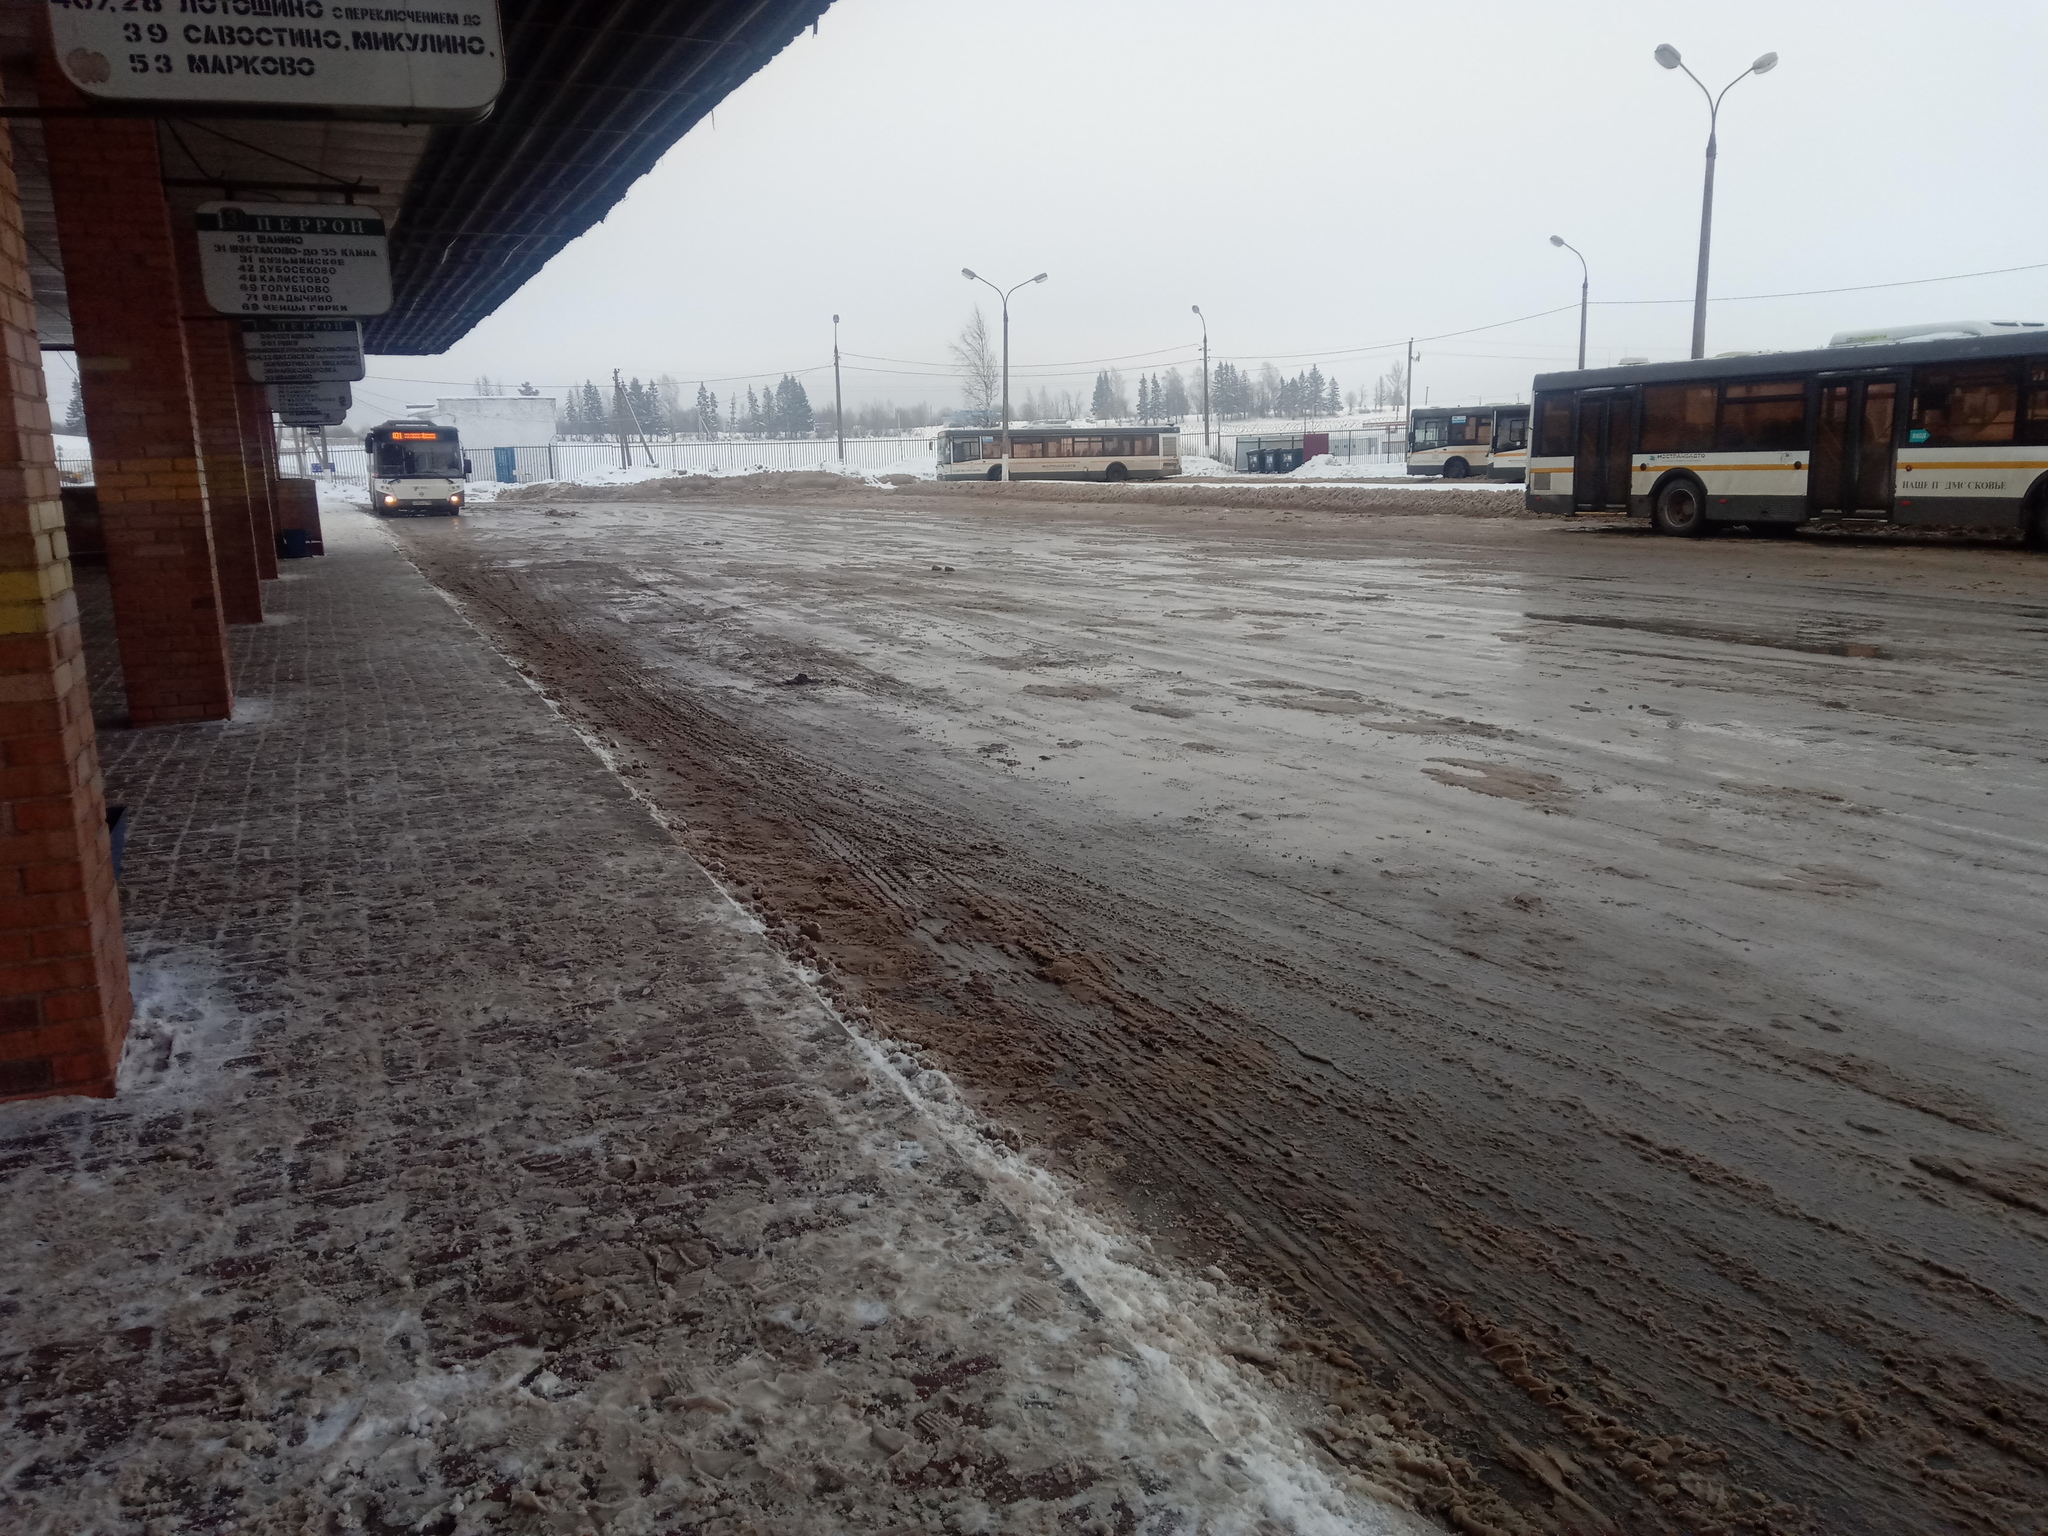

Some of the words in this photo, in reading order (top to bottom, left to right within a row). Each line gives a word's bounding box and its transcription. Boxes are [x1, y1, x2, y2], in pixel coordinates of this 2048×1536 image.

[180, 0, 323, 18] ЛОТОШИНО
[123, 22, 168, 43] 39
[129, 53, 173, 74] 53
[187, 53, 316, 76] МАРКОВО
[256, 217, 364, 233] ПЕРРОН
[237, 234, 251, 243] 31
[213, 244, 226, 253] 31
[240, 255, 253, 263] 31
[237, 264, 254, 272] 42
[259, 265, 337, 275] ДУБОСЕКОВО
[259, 274, 330, 284] КАЛИСТОВО
[261, 284, 330, 294] ГОЛУБЦОВО
[245, 293, 258, 301] 71
[262, 294, 333, 303] ВЛАДЫЧИНО
